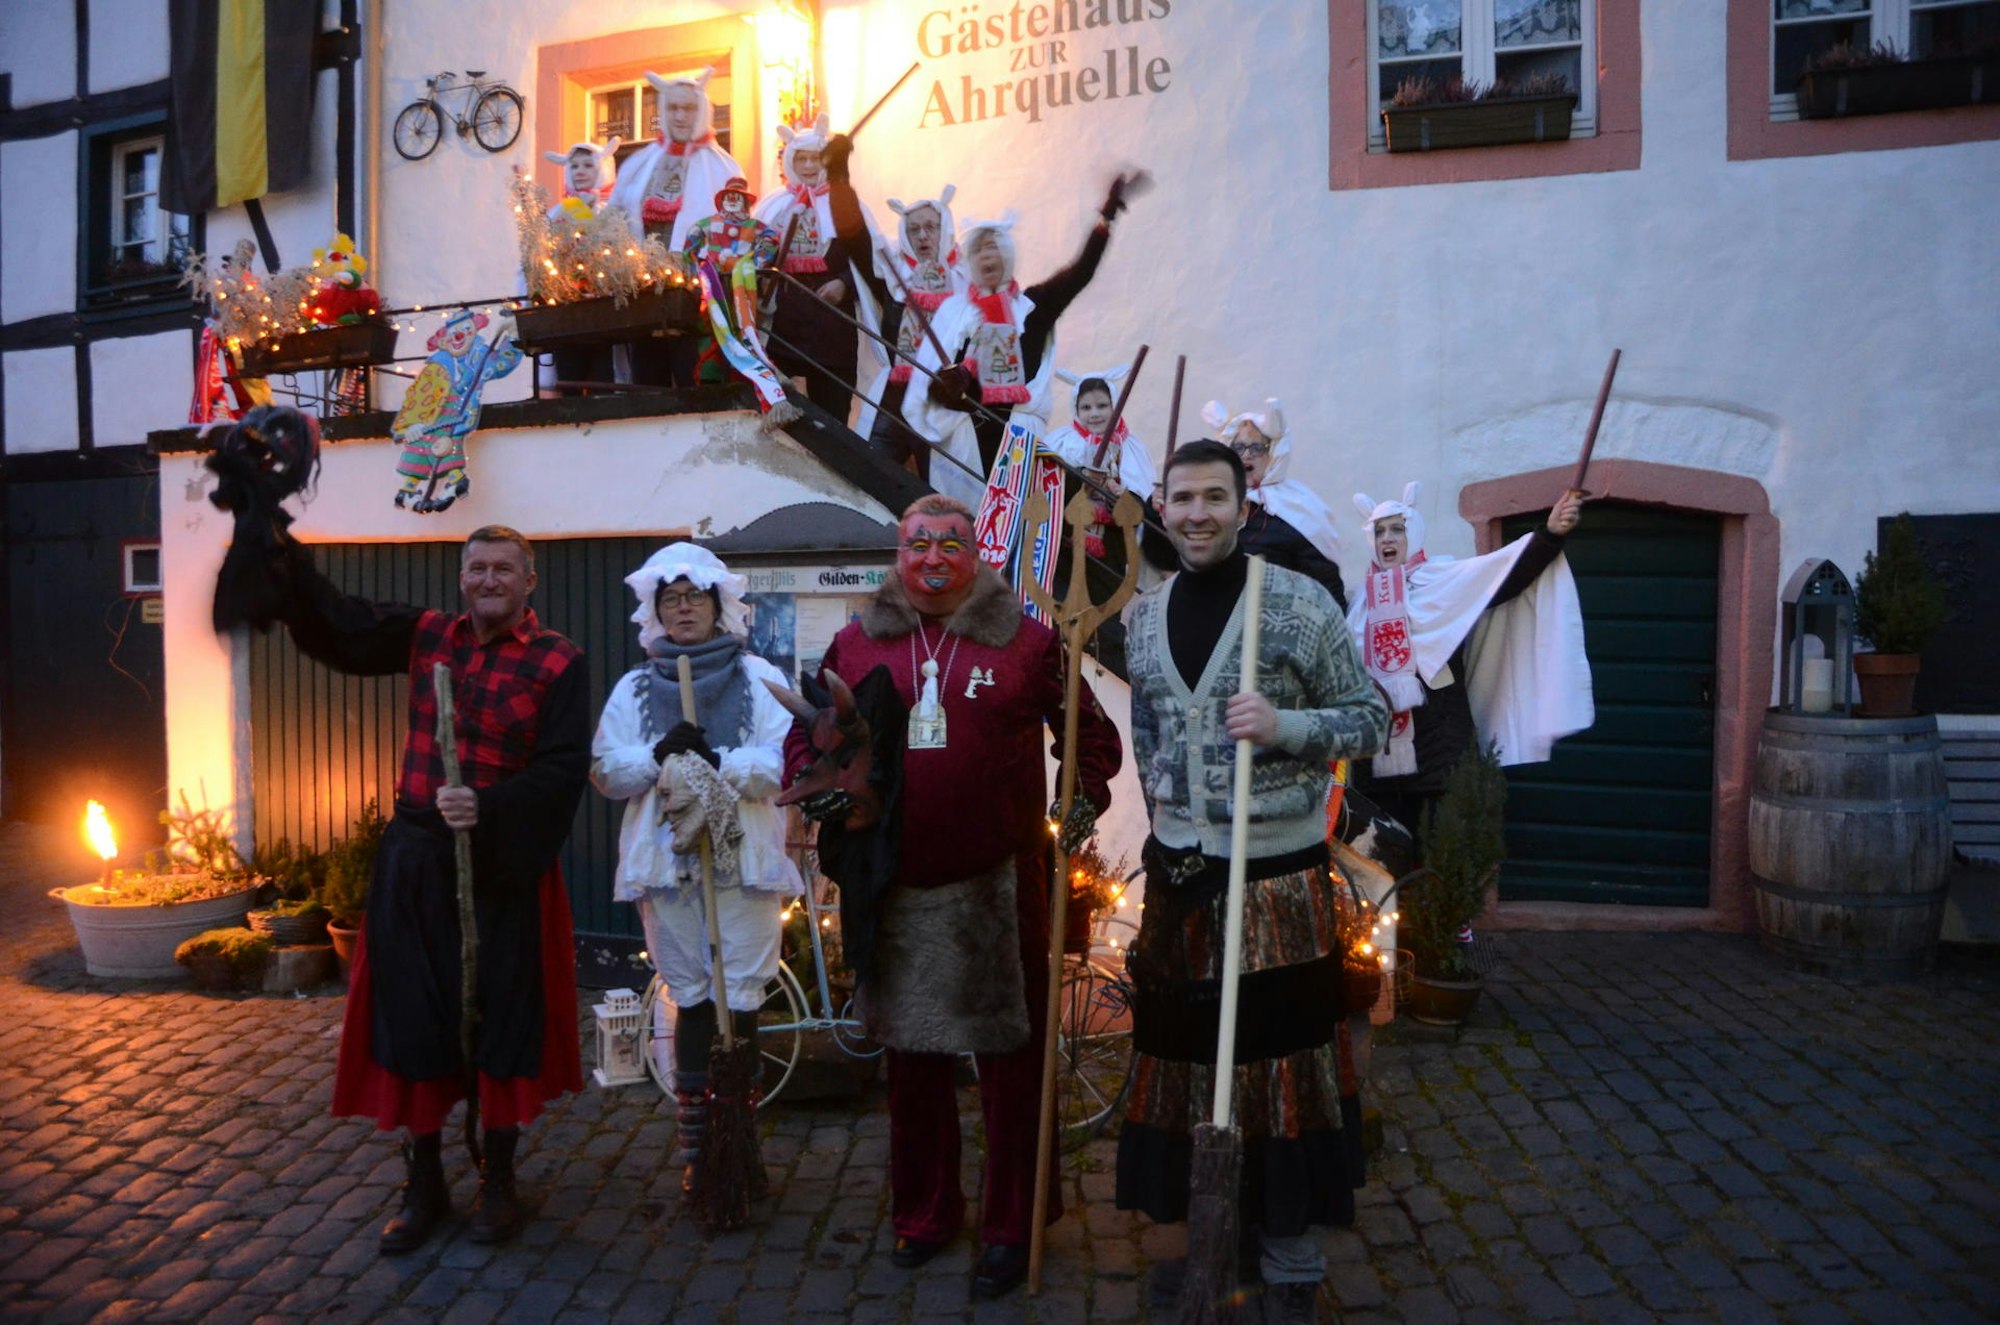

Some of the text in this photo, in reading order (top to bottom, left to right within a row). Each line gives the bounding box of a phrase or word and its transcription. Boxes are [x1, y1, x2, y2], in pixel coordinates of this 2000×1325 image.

[917, 0, 1171, 58] Gästehaus
[1010, 40, 1068, 72] ZUR
[917, 46, 1172, 129] Ahrquelle
